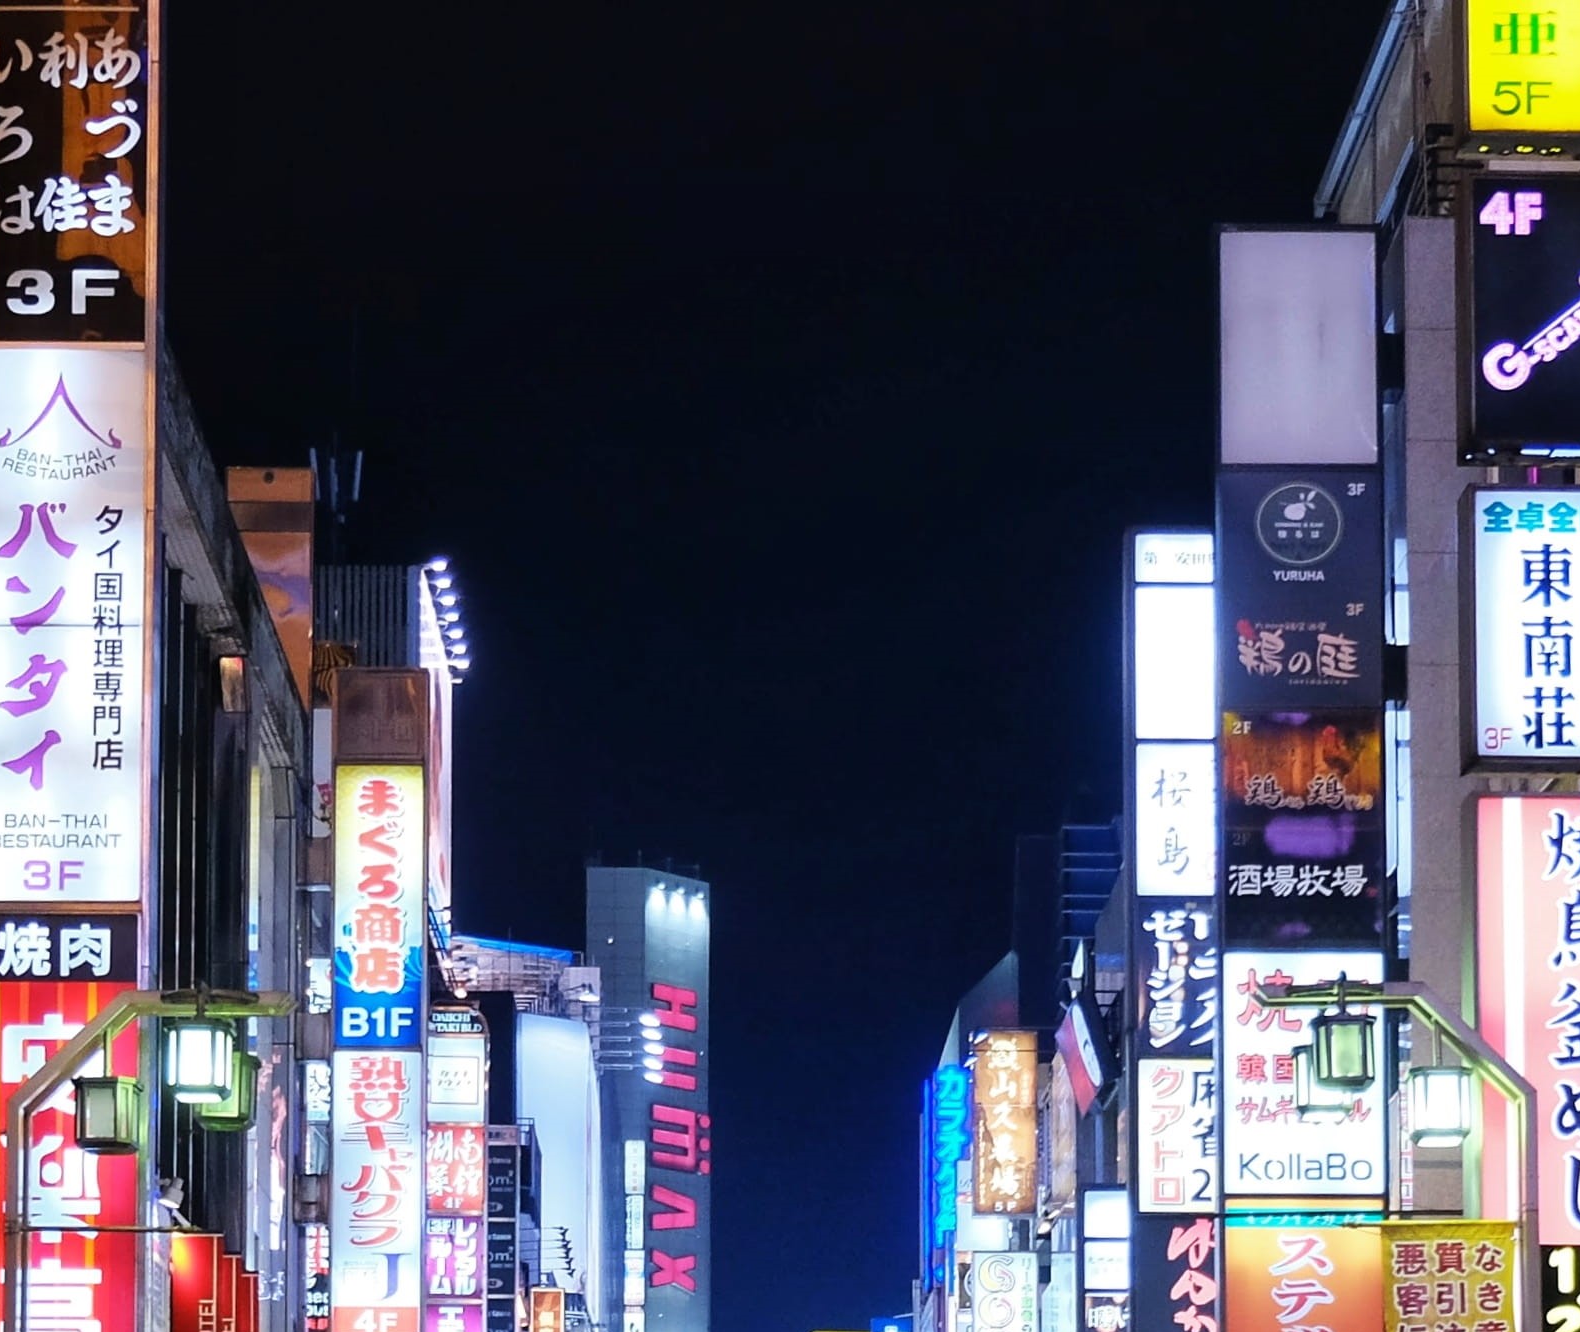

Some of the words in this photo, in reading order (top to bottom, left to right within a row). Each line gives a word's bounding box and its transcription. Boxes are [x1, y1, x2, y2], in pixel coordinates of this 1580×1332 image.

[1492, 80, 1553, 116] 5F
[85, 30, 142, 238] あづま
[1479, 191, 1544, 236] 4F
[5, 268, 120, 316] 3F
[1, 453, 118, 482] RESTAURANT
[16, 446, 103, 467] BAN-THAI
[1347, 482, 1366, 497] 3F
[1272, 569, 1325, 582] YURUHA
[1346, 602, 1365, 617] 3F
[92, 505, 125, 771] タイ国料理専門店
[1519, 542, 1576, 749] 東南荘
[1232, 720, 1253, 735] 2F
[1484, 727, 1513, 751] 3F
[3, 813, 109, 829] BAN-THAI
[21, 859, 85, 892] 3F
[353, 778, 408, 994] まぐろ商店
[1228, 864, 1368, 898] 酒場牧場
[341, 1005, 416, 1040] B1F
[1151, 1065, 1185, 1206] クアトロ
[1239, 1152, 1373, 1181] KollaBo
[1394, 1240, 1504, 1275] 悪質な
[1395, 1280, 1505, 1317] 客引き
